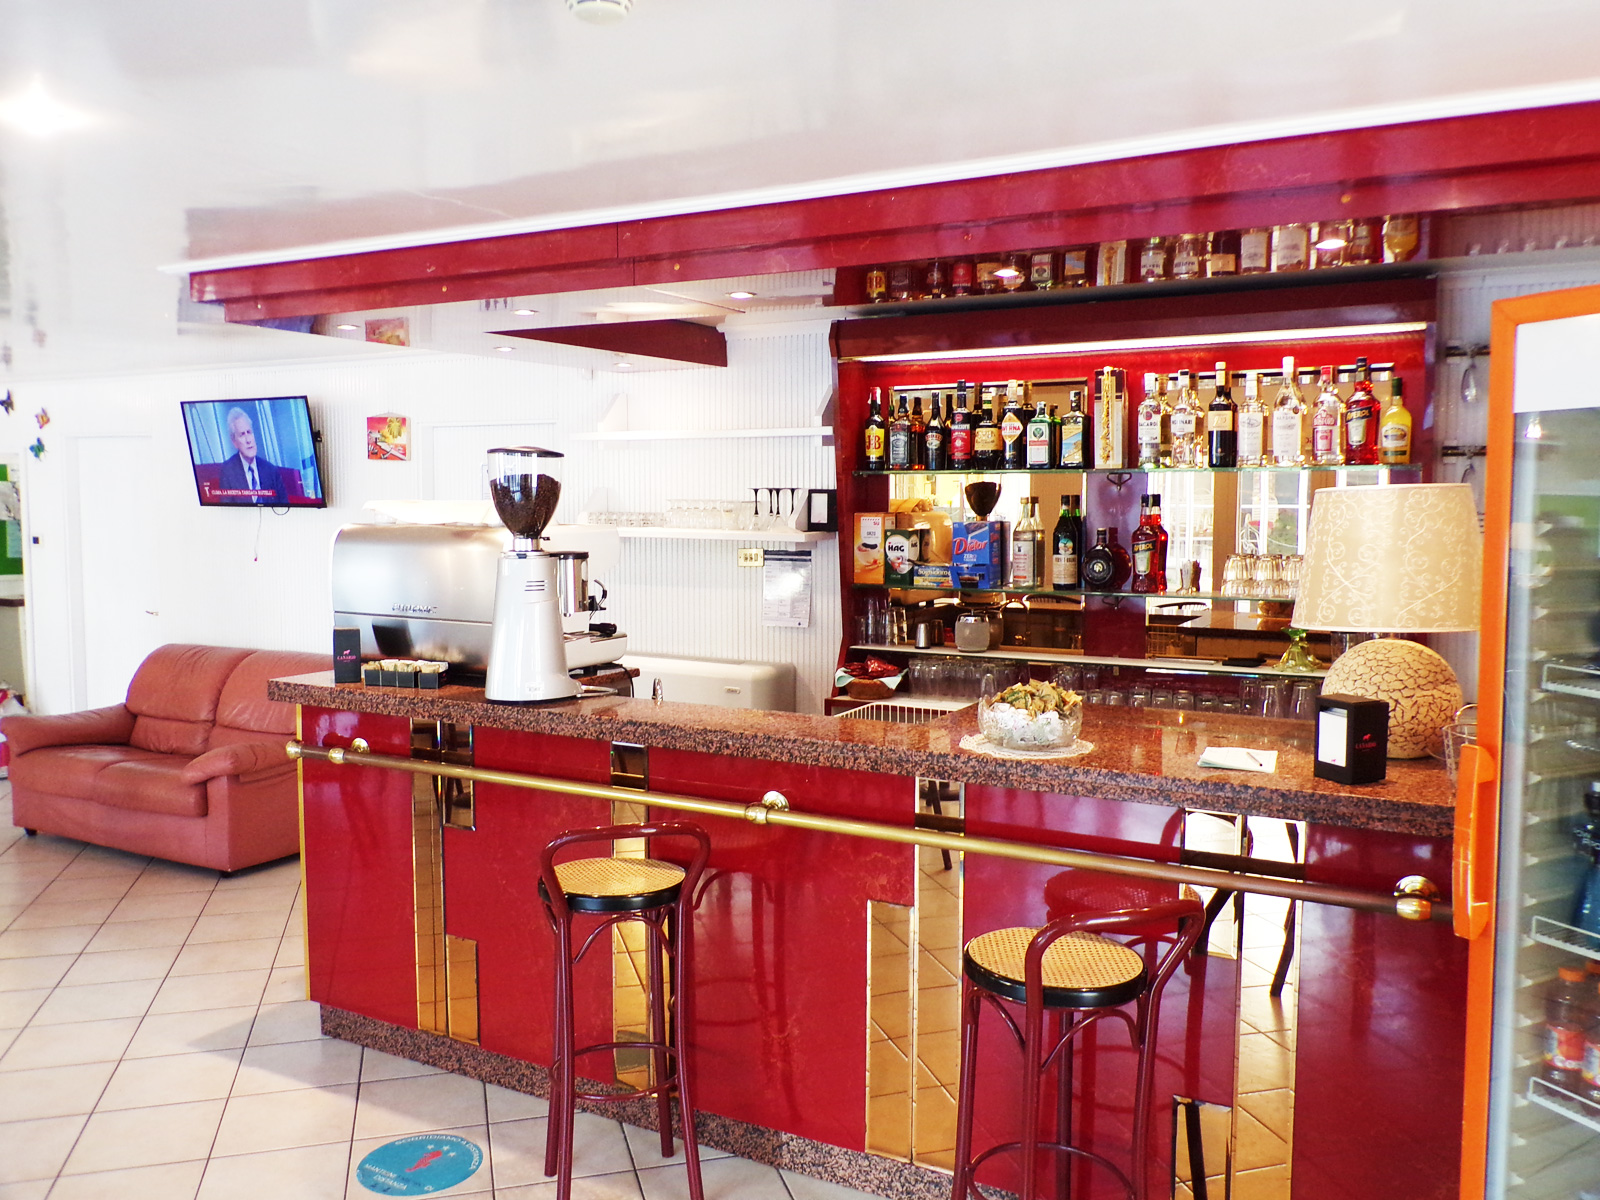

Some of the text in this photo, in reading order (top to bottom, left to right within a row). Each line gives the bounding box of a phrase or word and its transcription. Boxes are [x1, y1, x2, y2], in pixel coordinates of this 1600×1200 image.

[866, 434, 881, 451] JB
[953, 537, 989, 555] Dietor
[1133, 542, 1153, 552] APEROL
